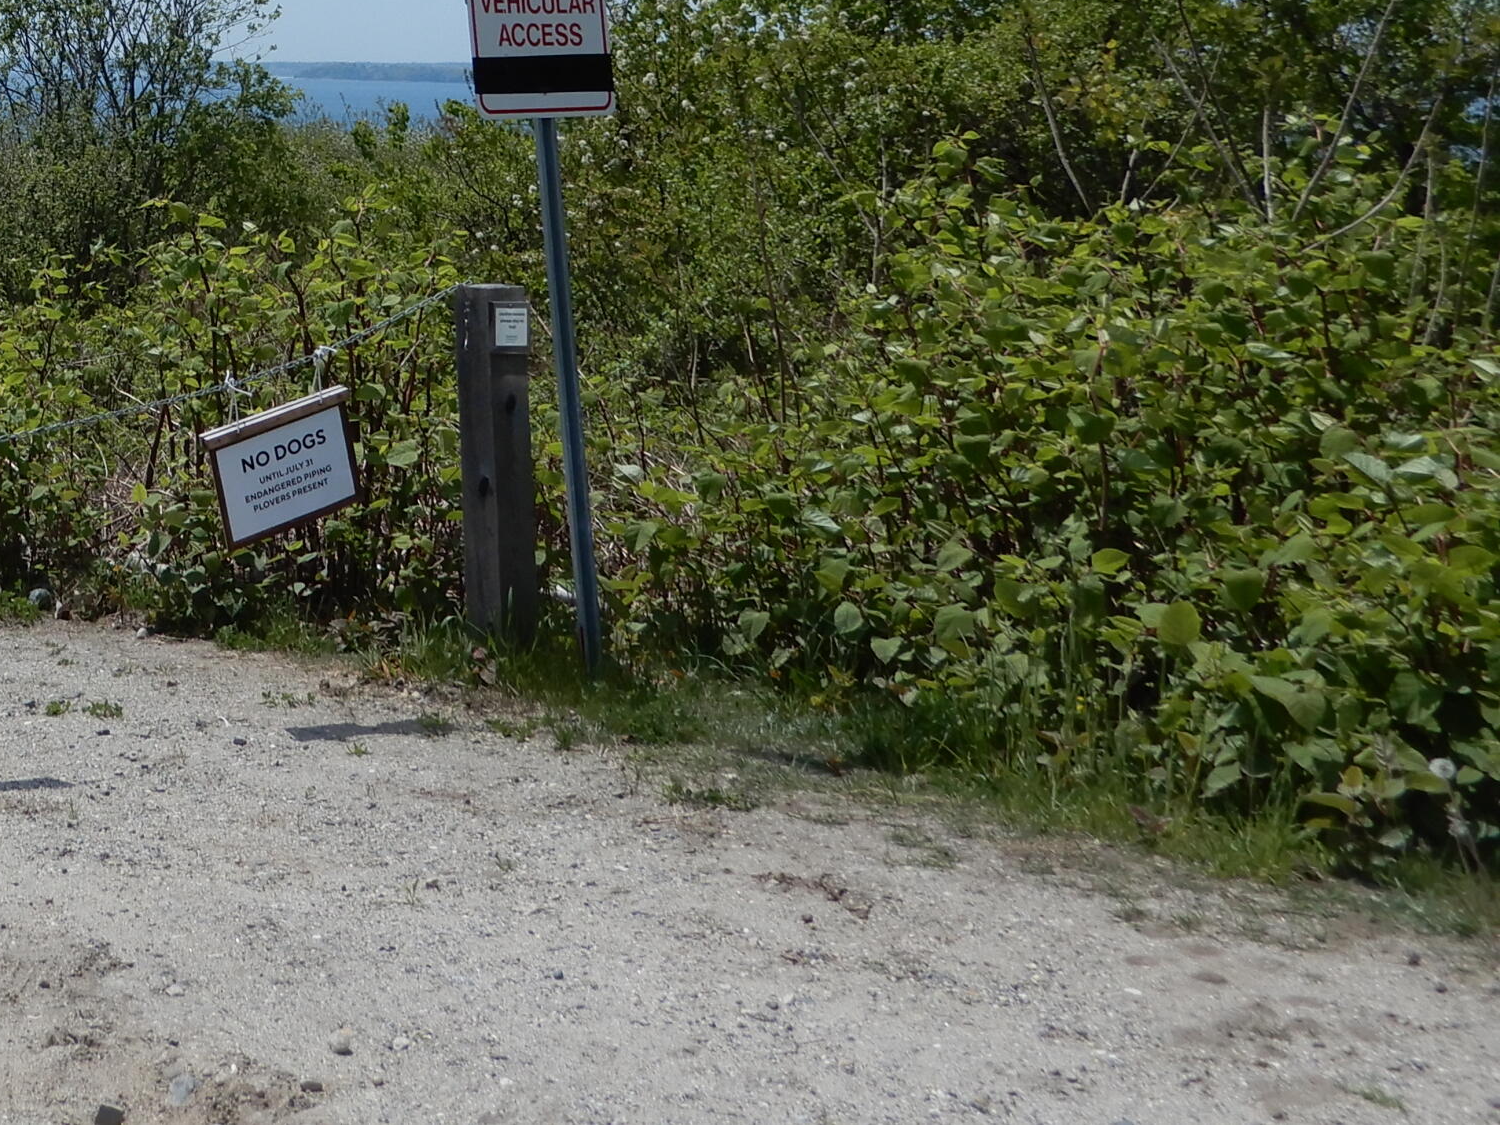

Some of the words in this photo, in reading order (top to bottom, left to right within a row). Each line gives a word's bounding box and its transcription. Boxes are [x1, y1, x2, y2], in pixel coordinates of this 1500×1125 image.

[499, 23, 582, 47] ACCESS
[241, 451, 270, 473] NO
[274, 429, 326, 461] DOGS
[245, 475, 302, 504] ENDANGERED
[303, 464, 332, 481] PIPING
[259, 467, 284, 485] UNTIL
[285, 461, 304, 476] JULY
[306, 458, 314, 468] 31
[253, 493, 291, 512] PLOVERS
[292, 478, 329, 497] PRESENT
